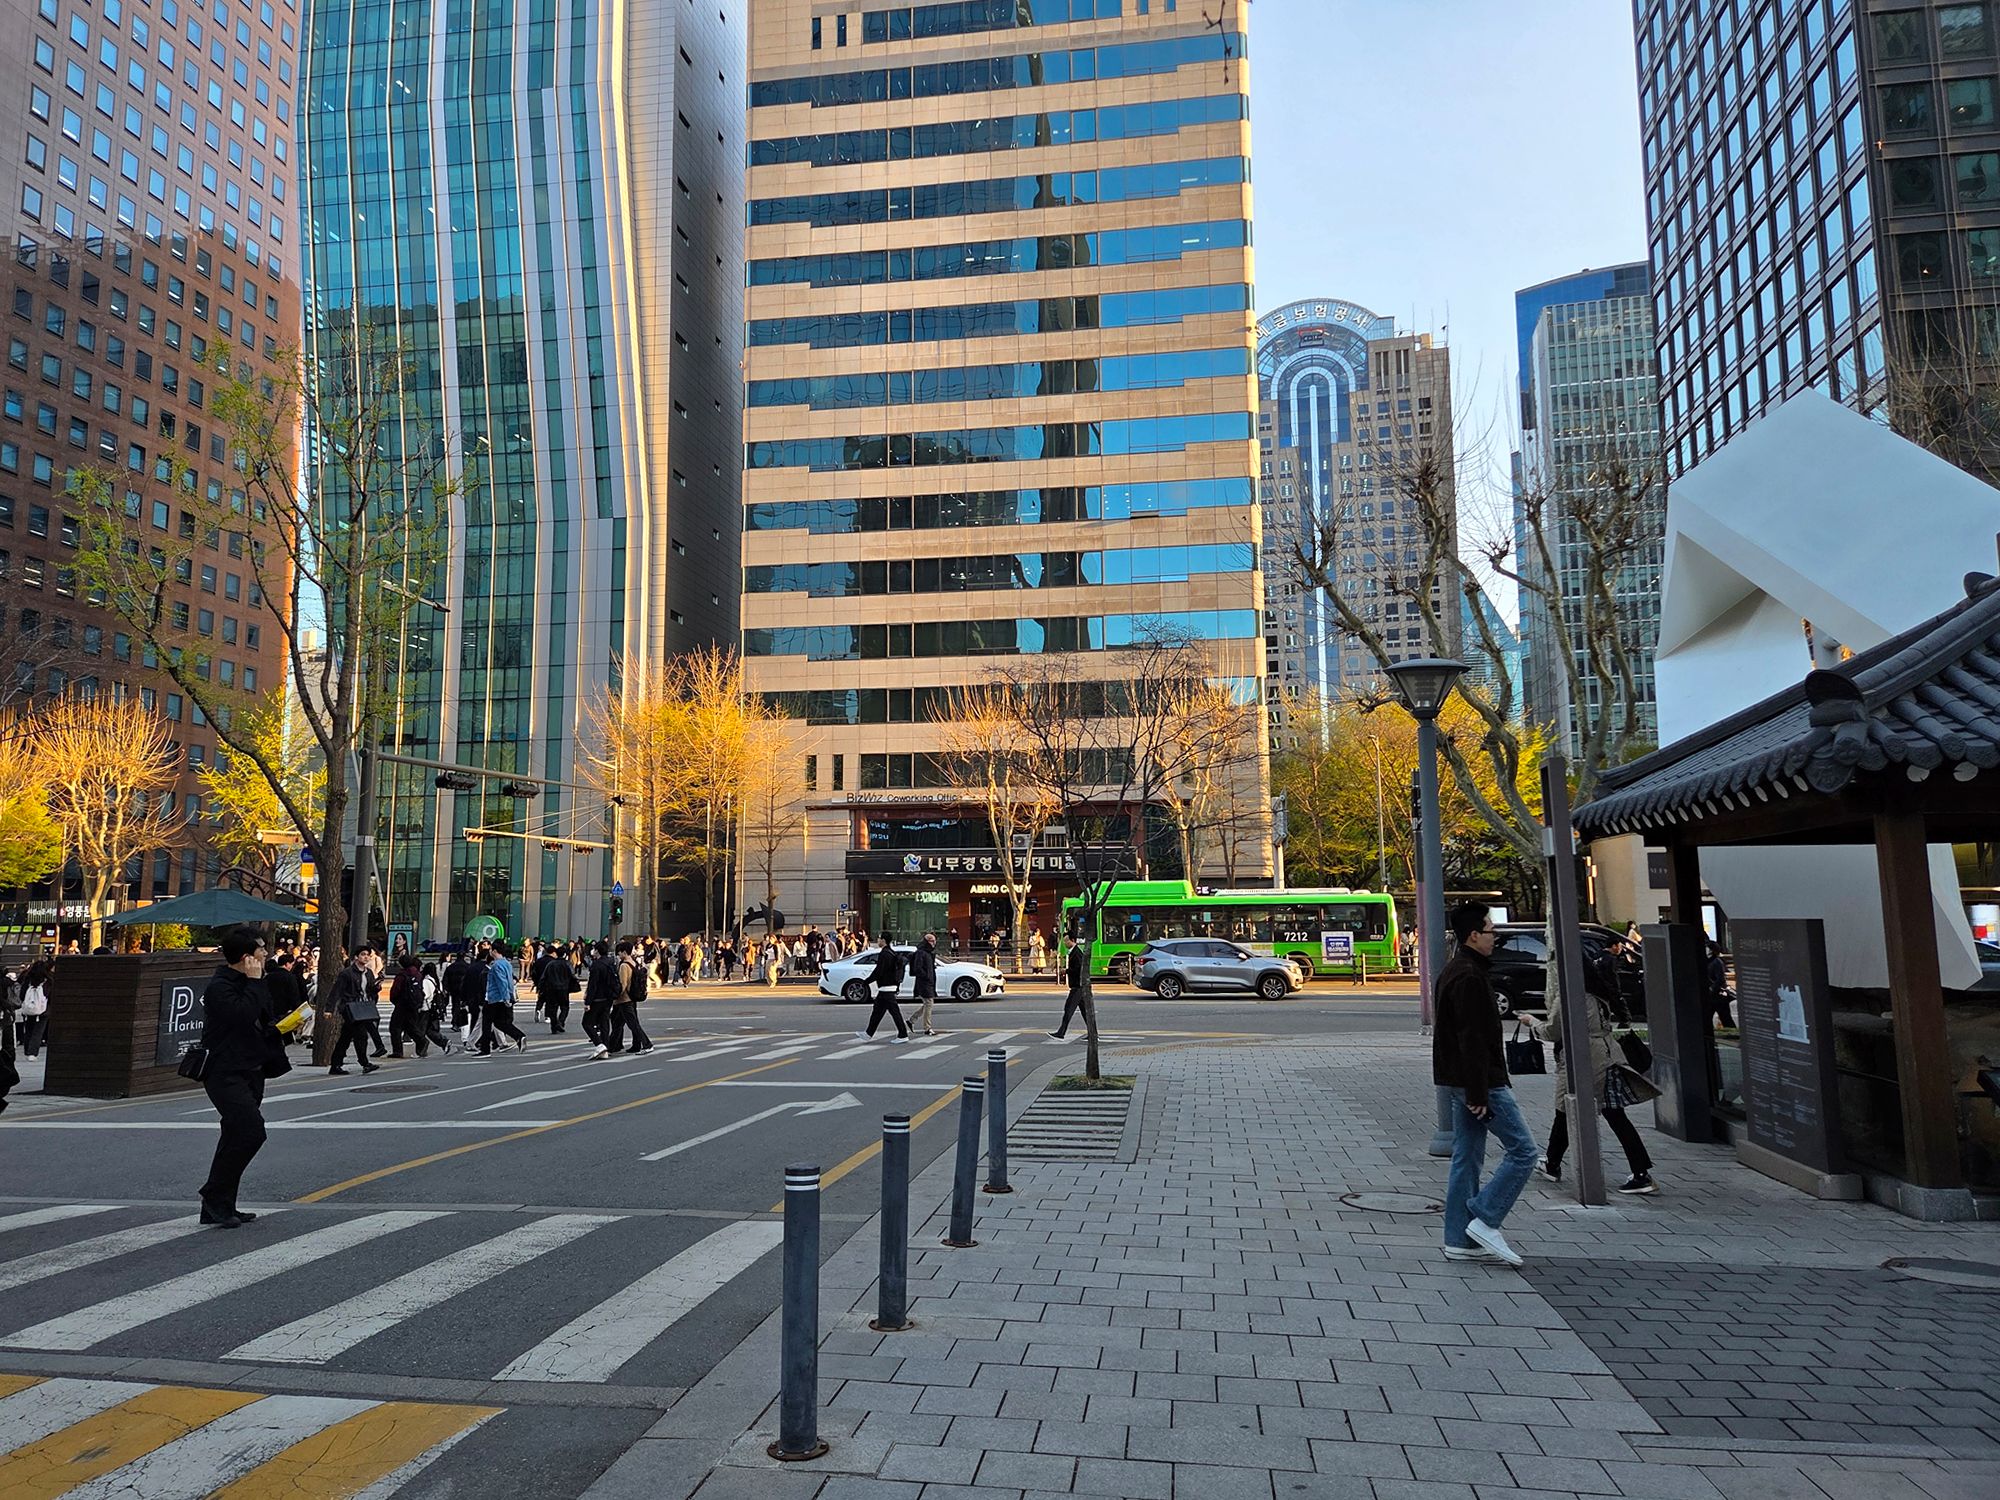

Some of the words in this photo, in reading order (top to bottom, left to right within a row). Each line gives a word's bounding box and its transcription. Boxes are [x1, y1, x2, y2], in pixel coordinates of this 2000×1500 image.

[1256, 304, 1367, 339] 예금보험공사
[970, 885, 999, 894] ABIKO
[1000, 885, 1032, 894] CRRY
[1284, 932, 1308, 941] 7212
[168, 986, 204, 1032] Parkin
